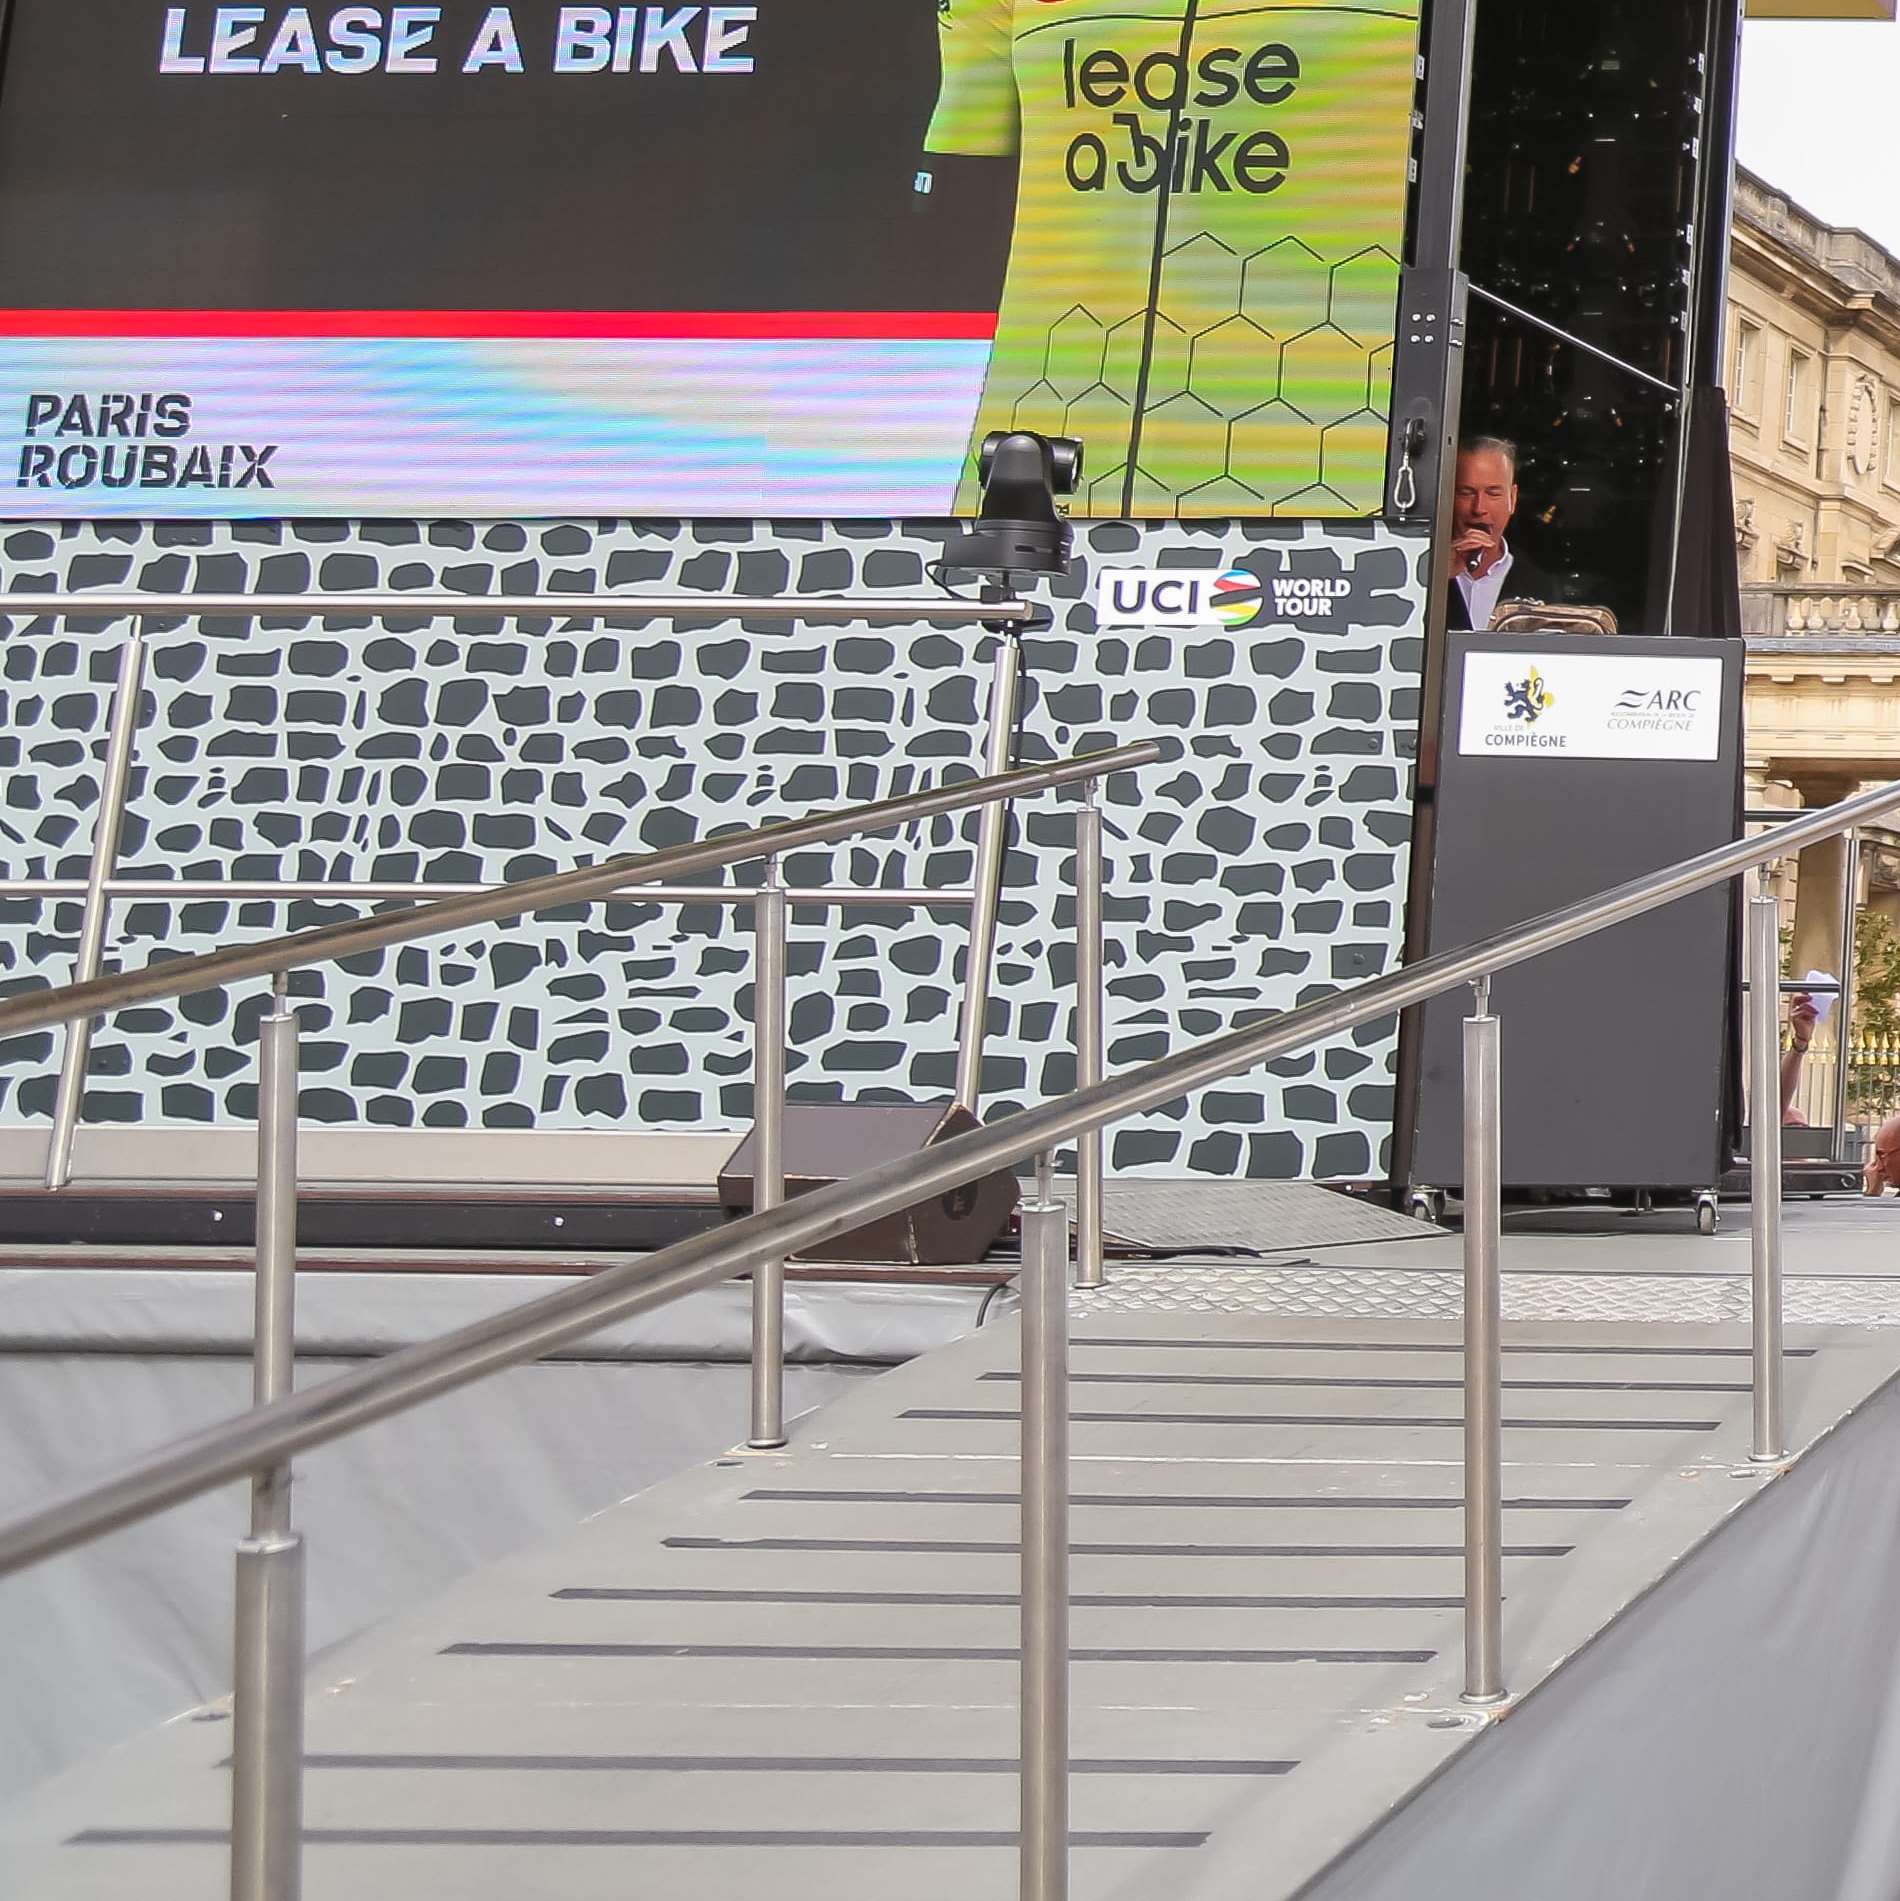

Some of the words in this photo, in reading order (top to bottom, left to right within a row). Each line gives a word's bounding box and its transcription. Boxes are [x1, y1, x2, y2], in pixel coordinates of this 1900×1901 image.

[159, 6, 443, 75] LEASE
[461, 6, 526, 75] A
[553, 6, 758, 75] BIKE
[1065, 37, 1301, 110] lease
[25, 392, 193, 438] PARIS
[16, 444, 280, 489] ROUBAIX
[1112, 580, 1199, 615] UCI
[1271, 578, 1352, 598] WORLD
[1275, 597, 1334, 617] TOUR
[1646, 689, 1702, 711] ARC
[1606, 718, 1693, 732] COMPIÈGNE
[1484, 732, 1567, 748] COMPIÈGNE
